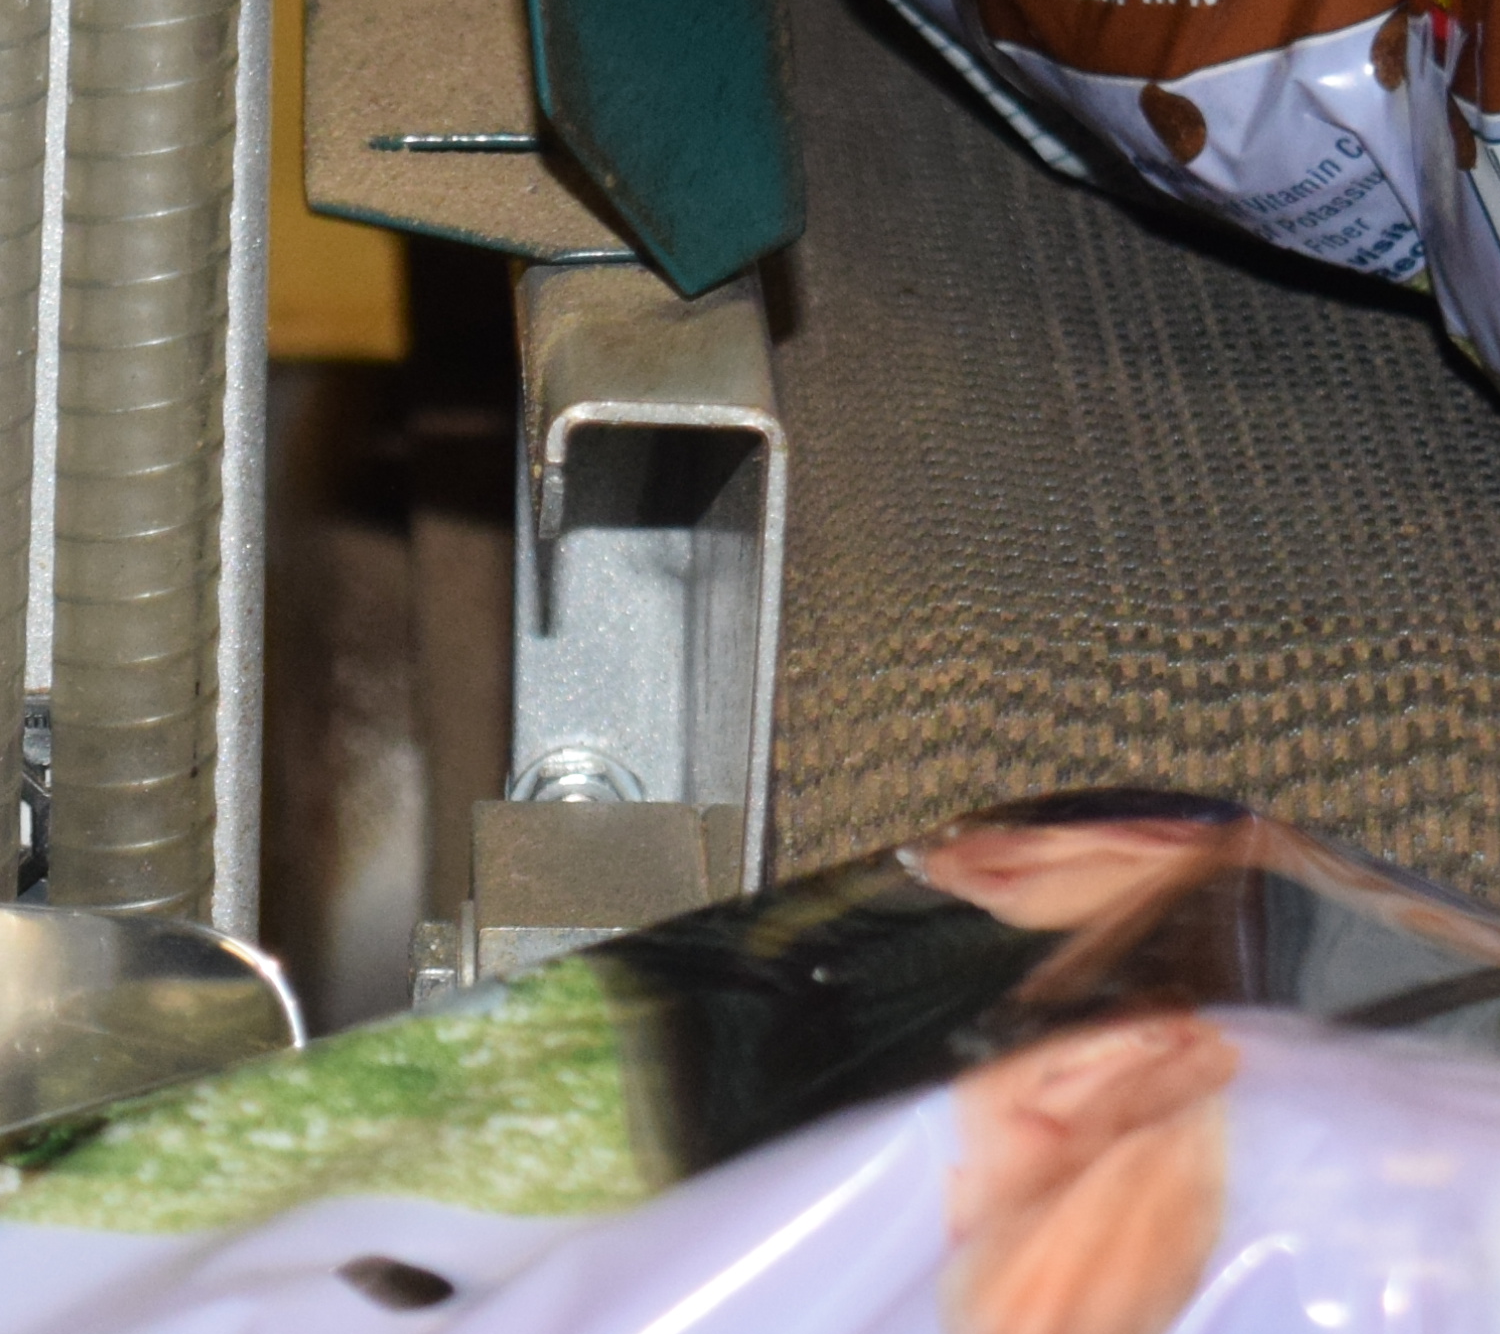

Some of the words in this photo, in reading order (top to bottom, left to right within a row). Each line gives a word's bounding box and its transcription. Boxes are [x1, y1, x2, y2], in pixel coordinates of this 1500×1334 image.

[1244, 158, 1342, 214] Vitamin
[1334, 136, 1364, 160] C
[1278, 168, 1386, 234] Potassiu
[1303, 217, 1371, 255] Fiber
